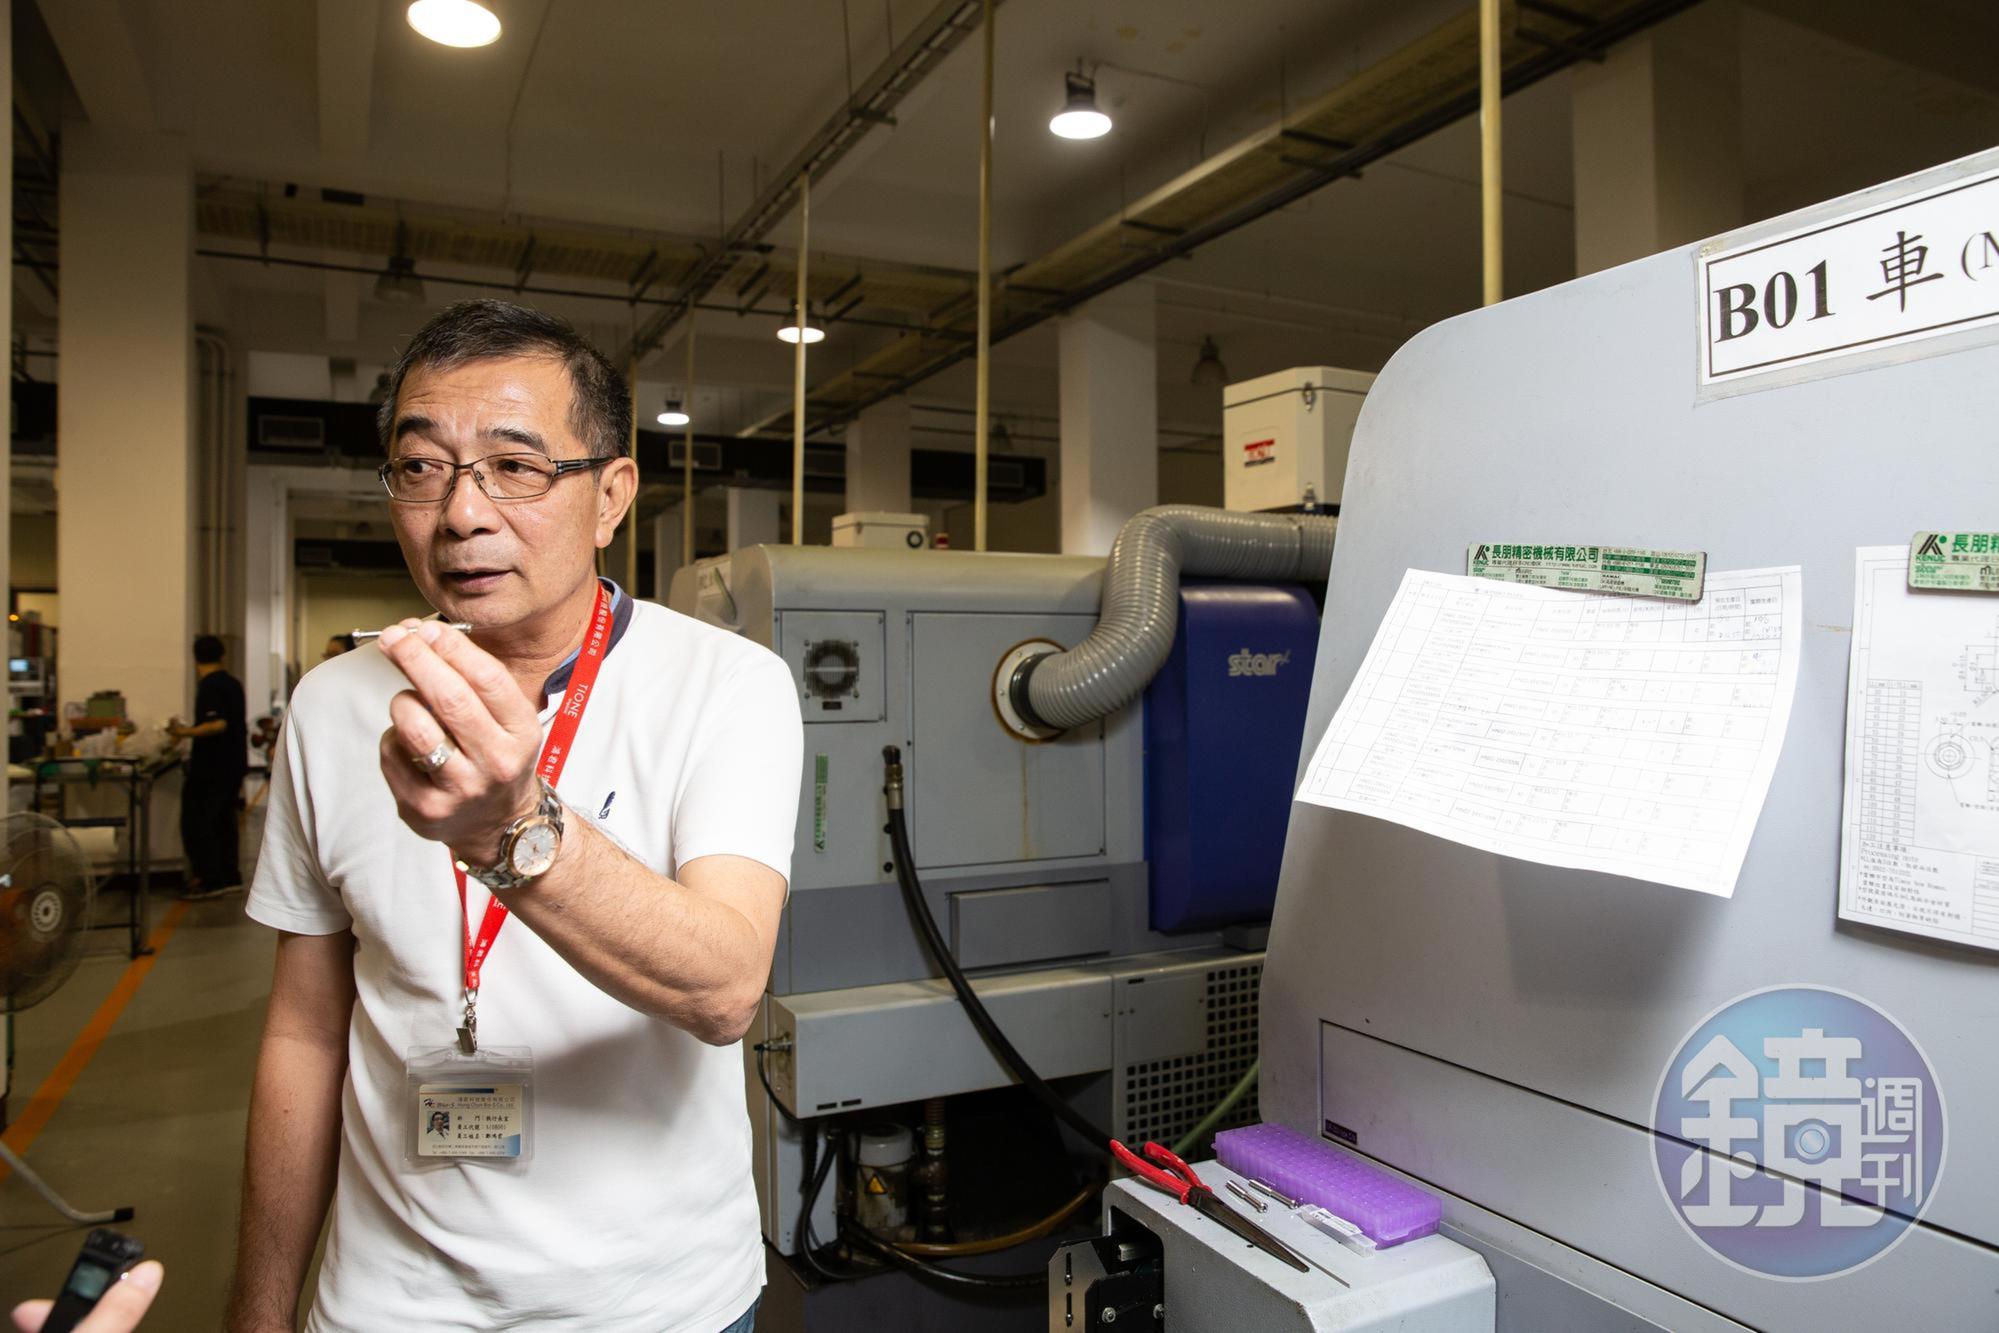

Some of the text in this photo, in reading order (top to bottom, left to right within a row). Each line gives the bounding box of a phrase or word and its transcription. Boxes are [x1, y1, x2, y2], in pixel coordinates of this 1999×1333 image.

[1713, 259, 1837, 344] B01
[1866, 231, 1945, 314] 車
[1492, 545, 1599, 563] 長朋精密機械有限公司
[1228, 648, 1282, 676] star
[567, 683, 589, 718] TIONE
